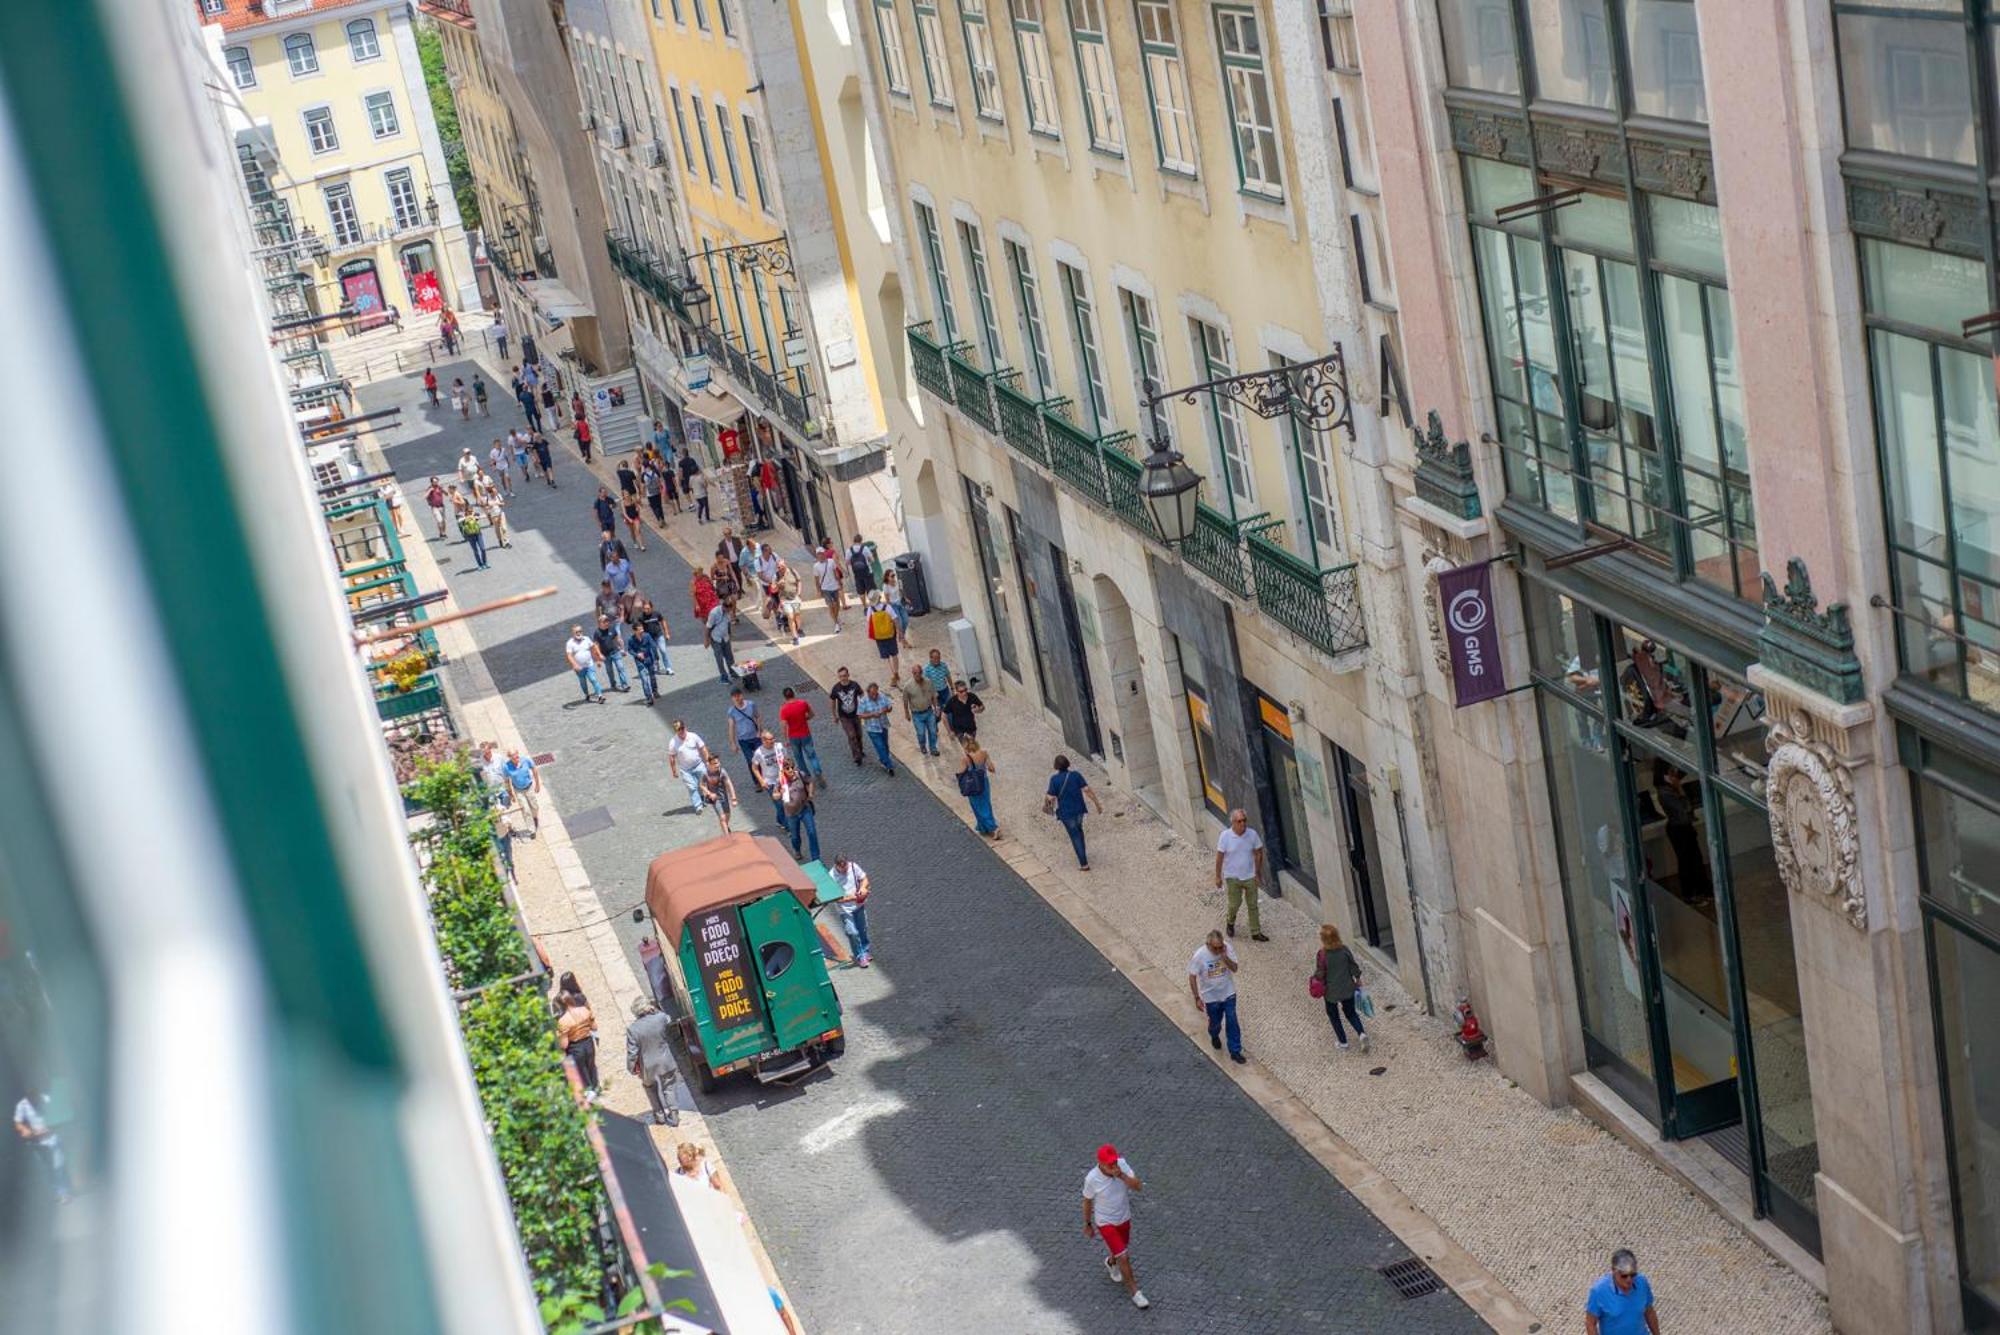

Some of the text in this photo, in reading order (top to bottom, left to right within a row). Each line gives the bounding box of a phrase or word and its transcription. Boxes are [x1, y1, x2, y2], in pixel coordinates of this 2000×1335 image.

[1464, 636, 1484, 677] GMS
[701, 921, 730, 942] FADO
[704, 944, 739, 966] PREÇO
[715, 976, 744, 996] FADO
[719, 998, 752, 1020] PRICE
